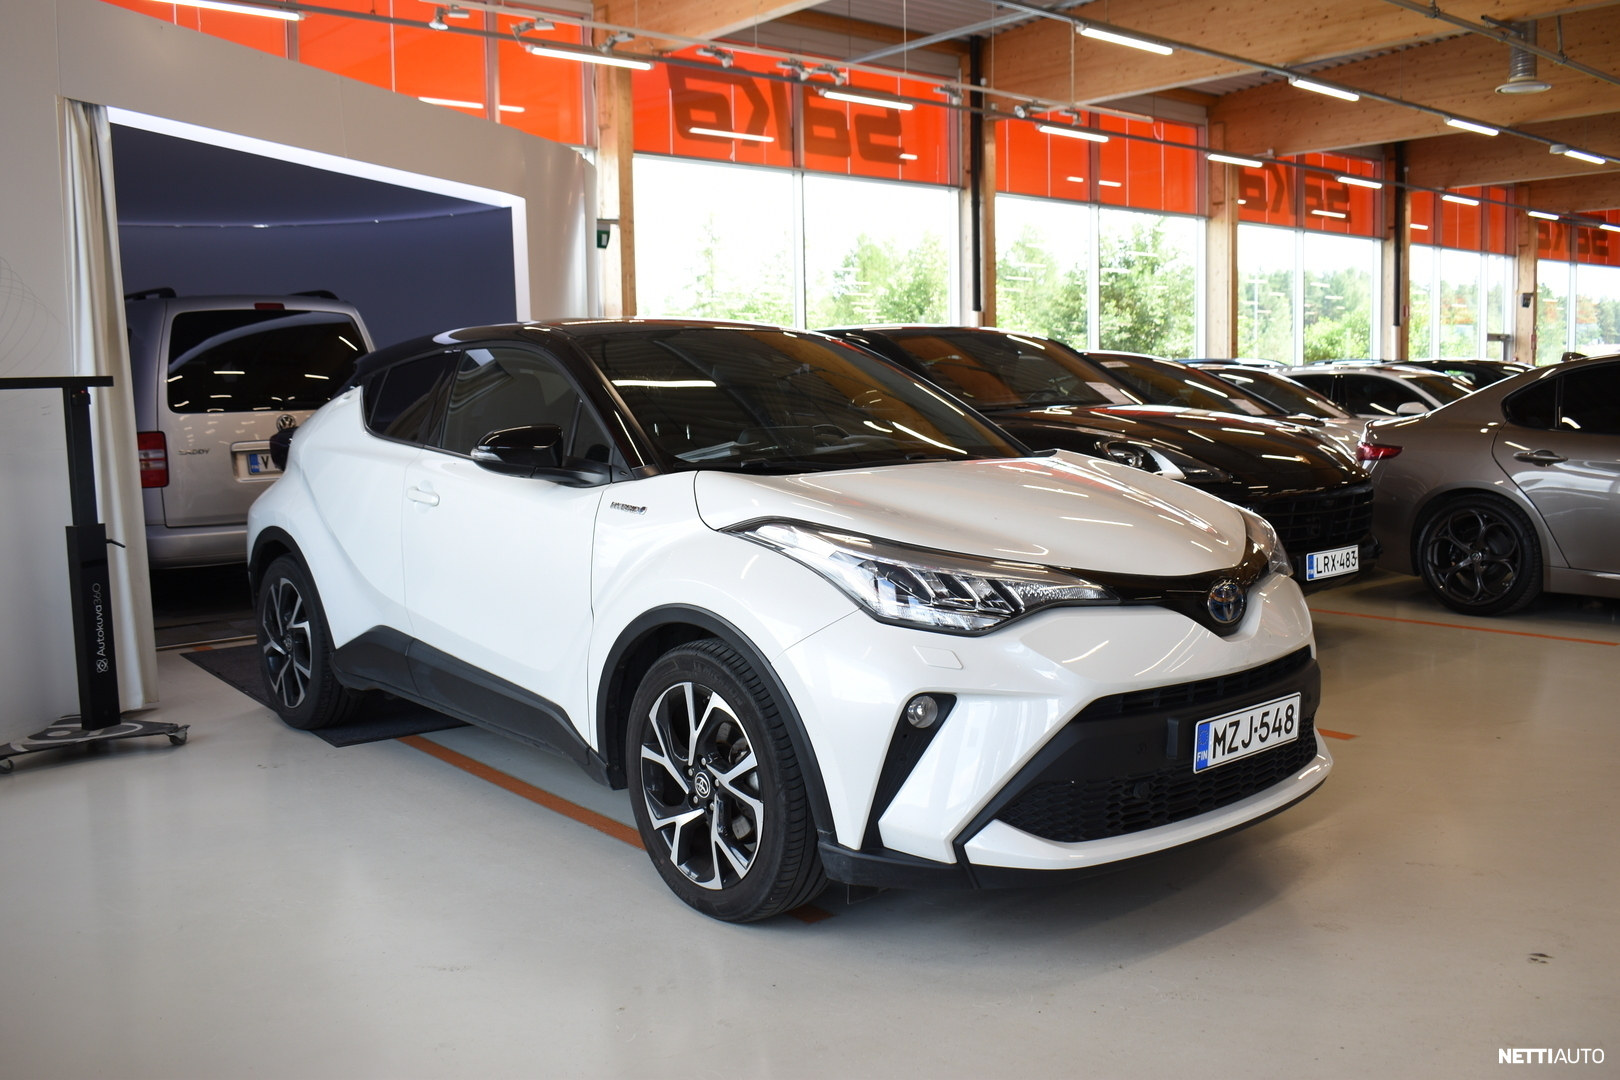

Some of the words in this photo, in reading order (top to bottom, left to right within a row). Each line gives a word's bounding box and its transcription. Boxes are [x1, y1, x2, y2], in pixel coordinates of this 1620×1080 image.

[1316, 550, 1358, 575] LRX-483
[92, 582, 106, 657] Autokuva360
[1212, 703, 1295, 760] MZJ-548
[1196, 750, 1208, 762] FIN
